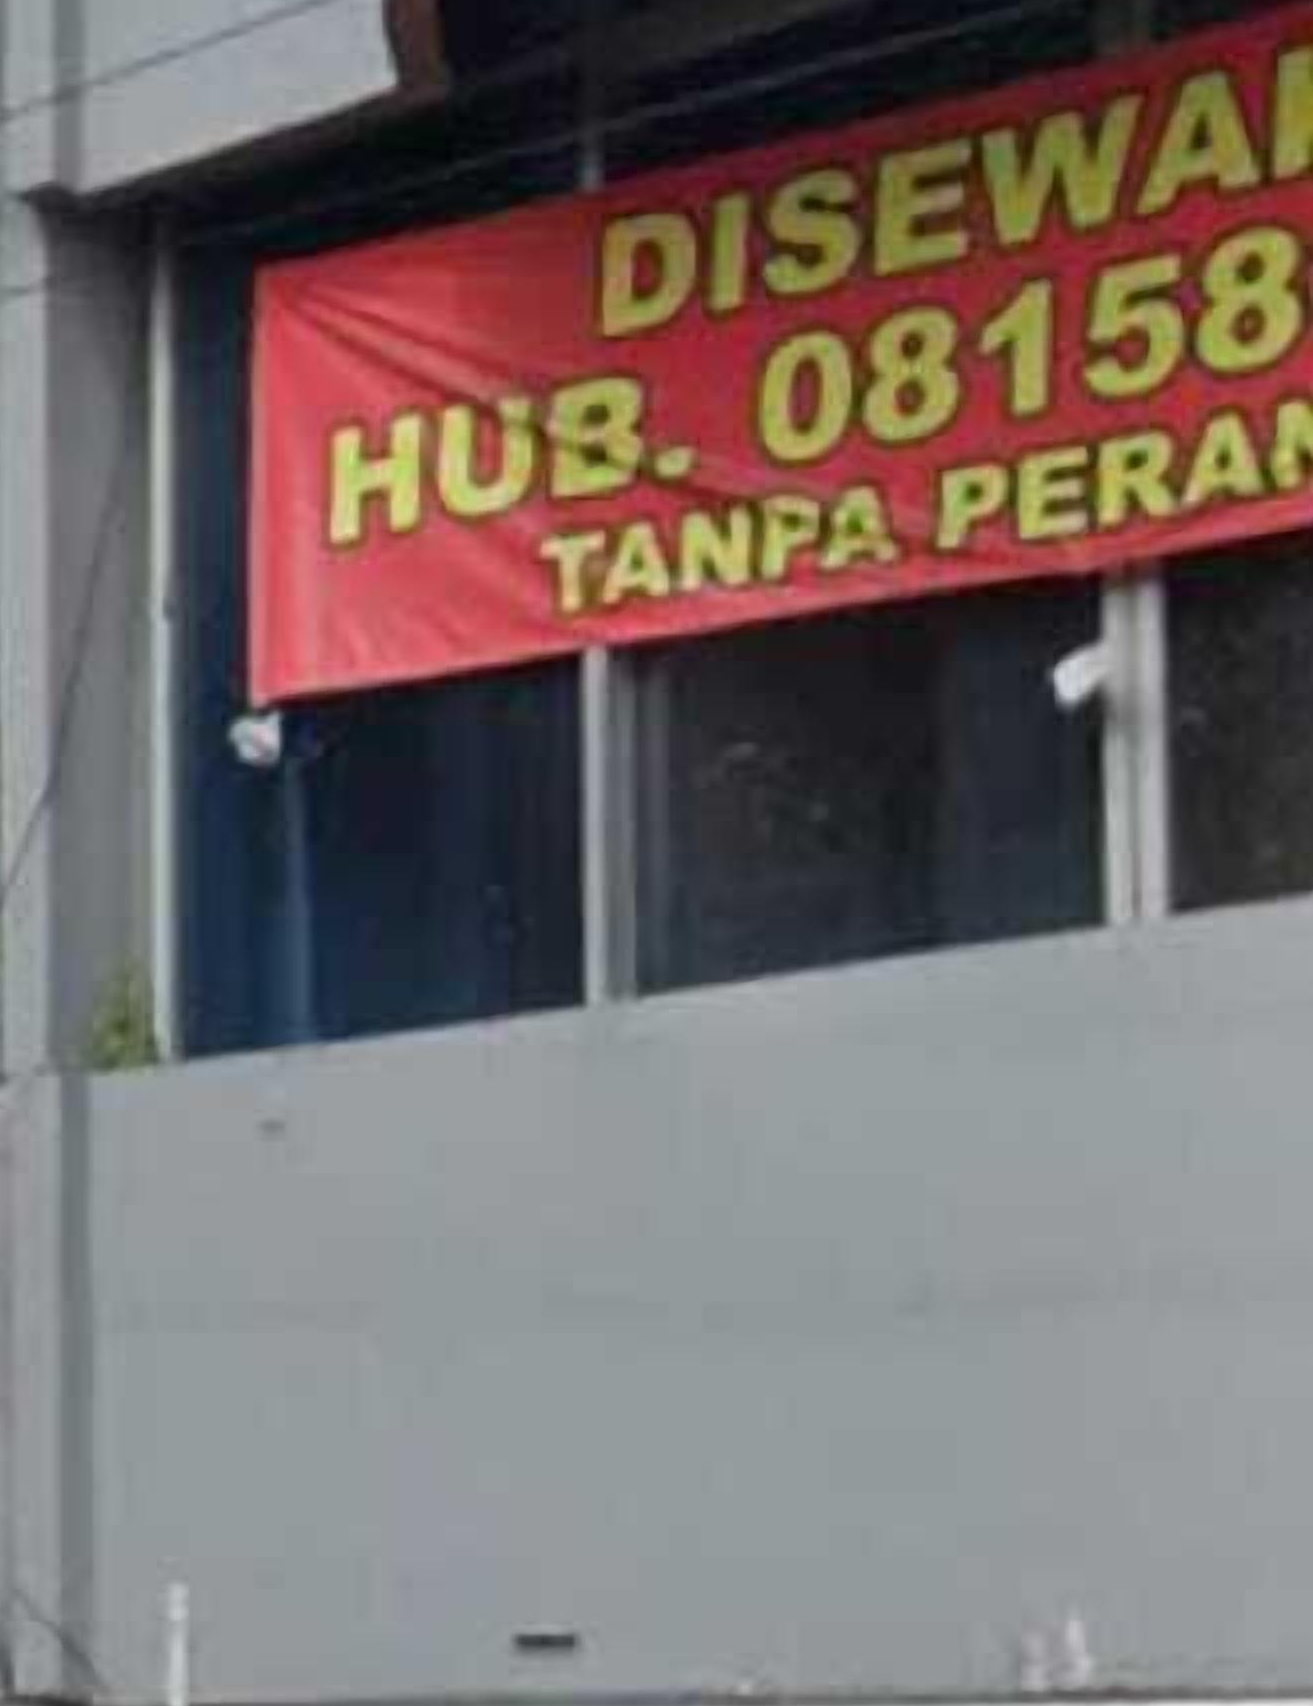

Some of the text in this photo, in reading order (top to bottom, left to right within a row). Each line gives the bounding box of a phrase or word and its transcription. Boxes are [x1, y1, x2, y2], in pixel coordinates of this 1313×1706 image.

[326, 225, 1305, 547] HUB. 08158
[541, 485, 899, 613] TANPA
